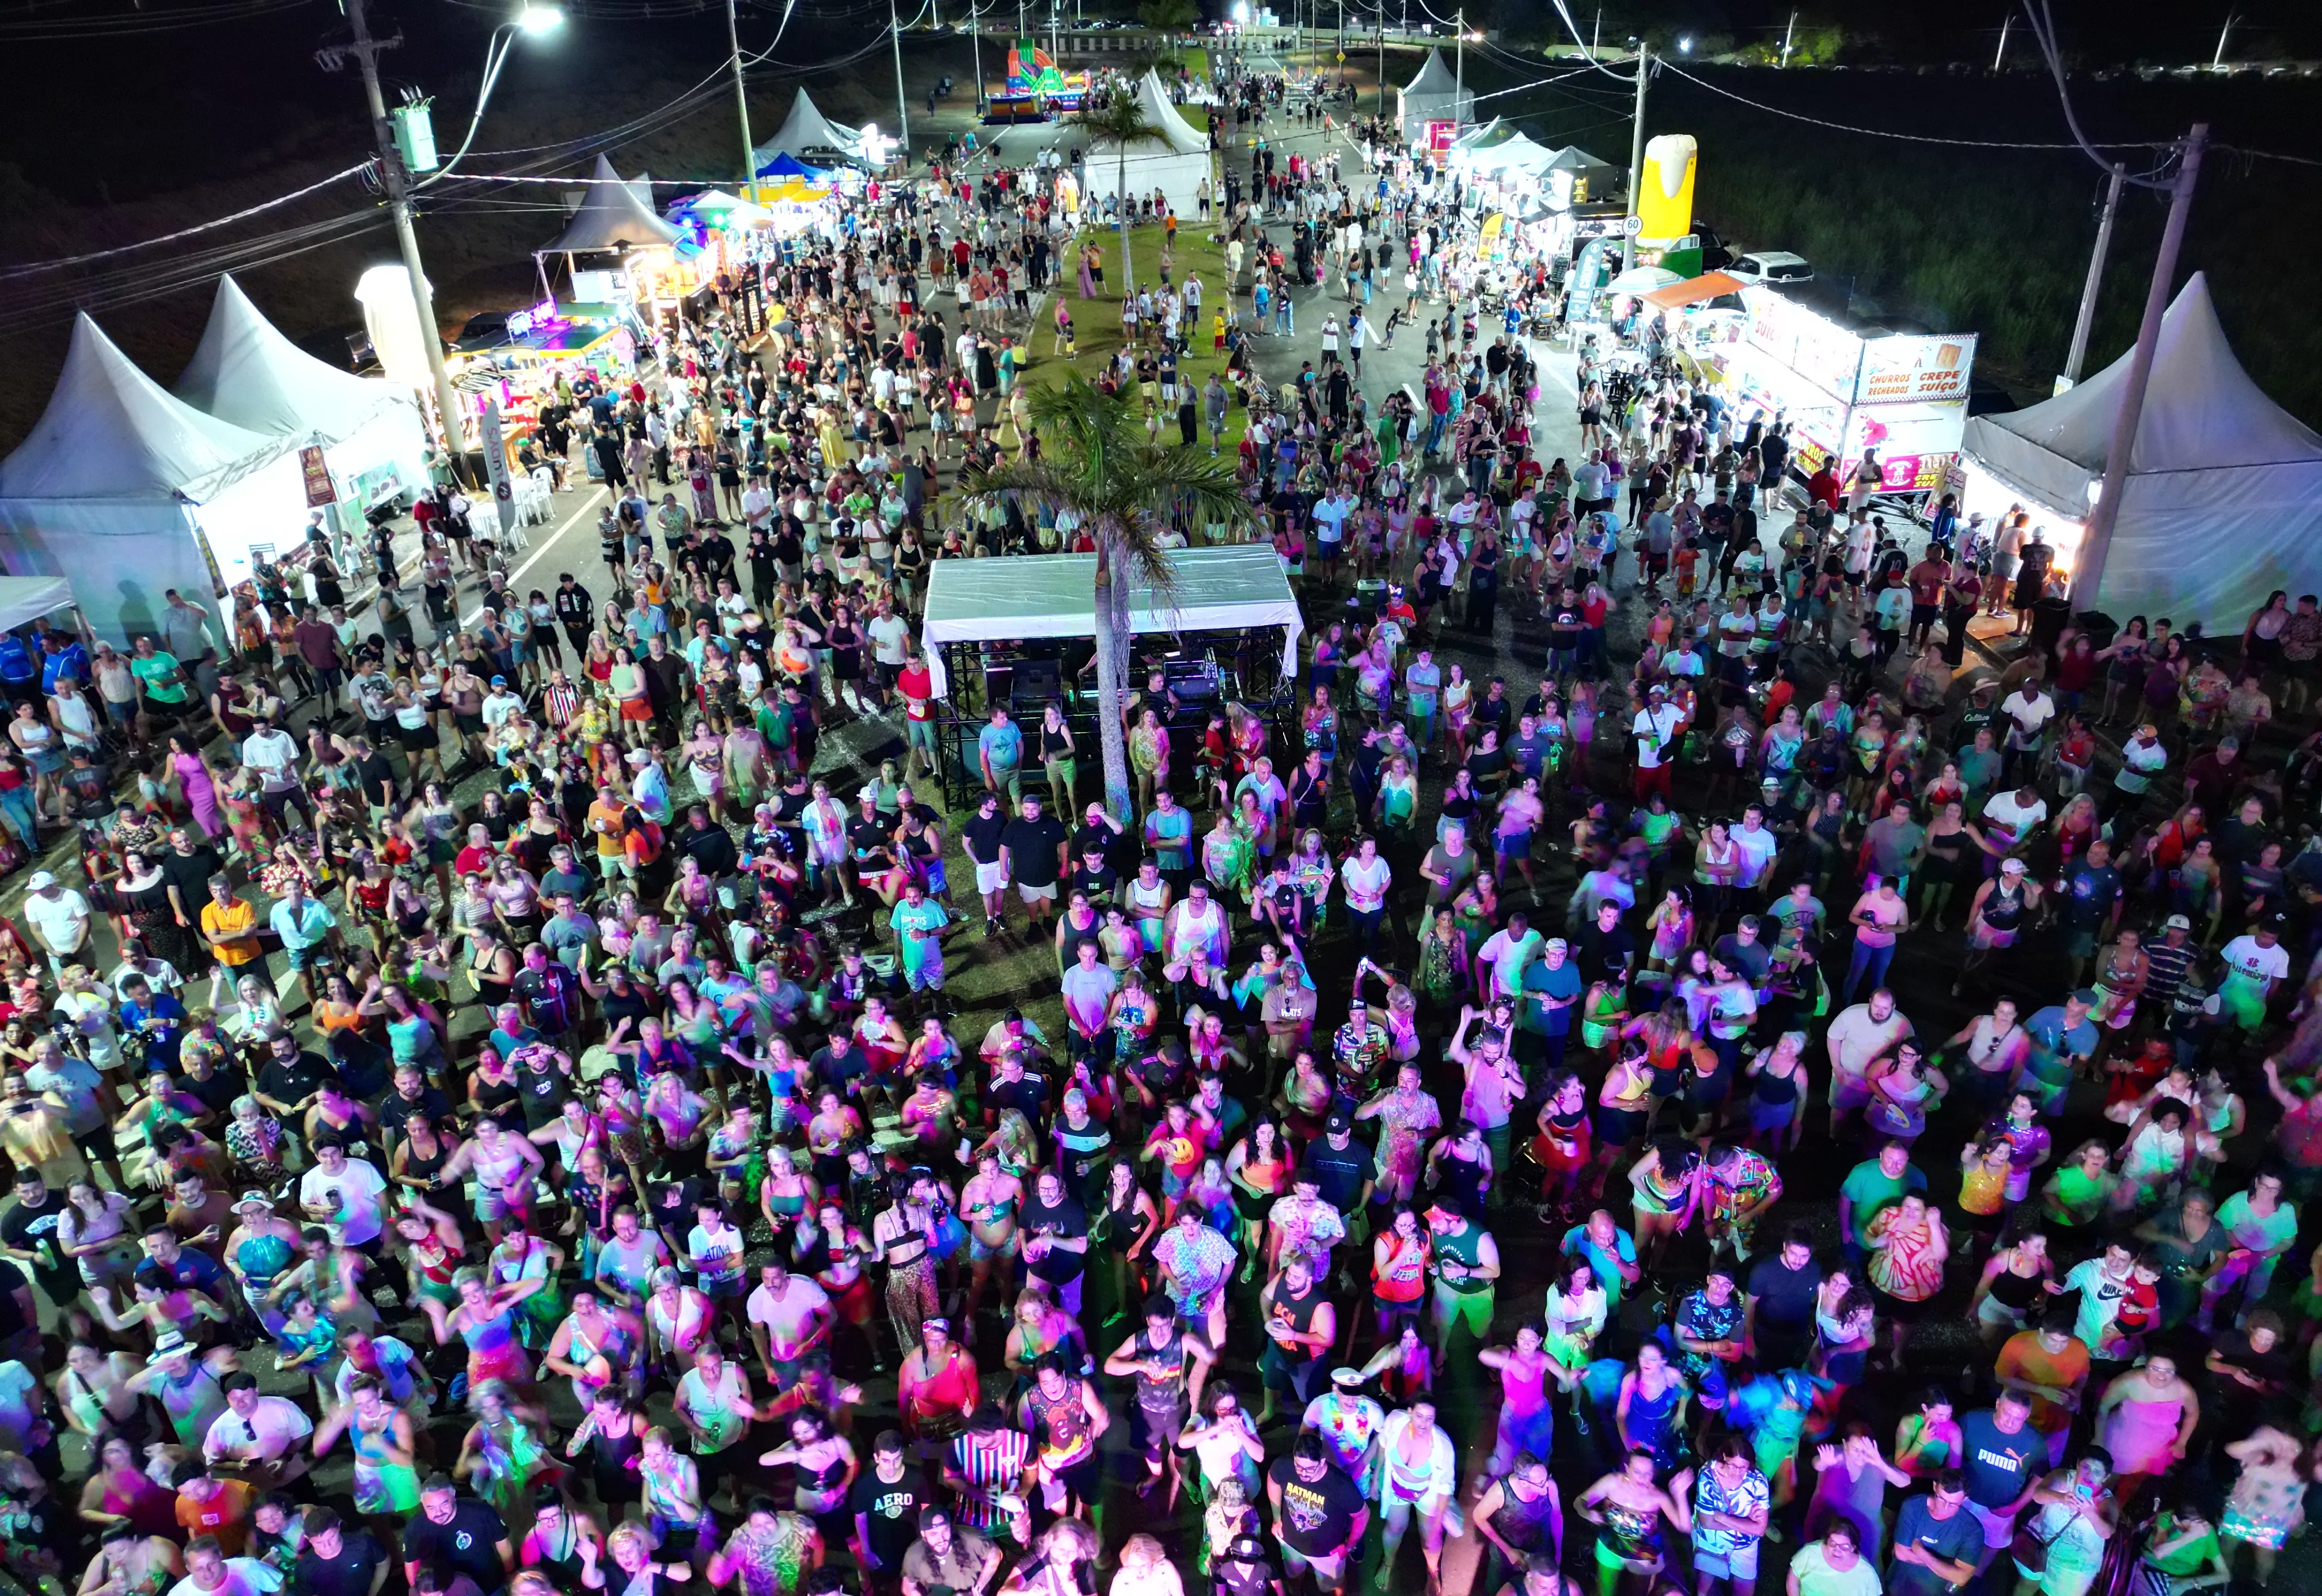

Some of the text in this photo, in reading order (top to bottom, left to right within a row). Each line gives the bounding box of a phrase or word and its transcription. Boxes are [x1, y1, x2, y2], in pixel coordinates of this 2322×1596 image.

[1627, 219, 1638, 229] 60
[1869, 374, 1911, 385] CHURROS
[1919, 370, 1960, 381] CREPE
[1868, 385, 1910, 396] RECHEADOS
[487, 427, 504, 477] LUDY'S
[1914, 473, 1937, 481] CRE
[901, 915, 927, 926] HORETS
[1978, 1448, 2017, 1472] PUMA
[1286, 1481, 1325, 1507] BATMAN
[874, 1492, 913, 1511] AERO
